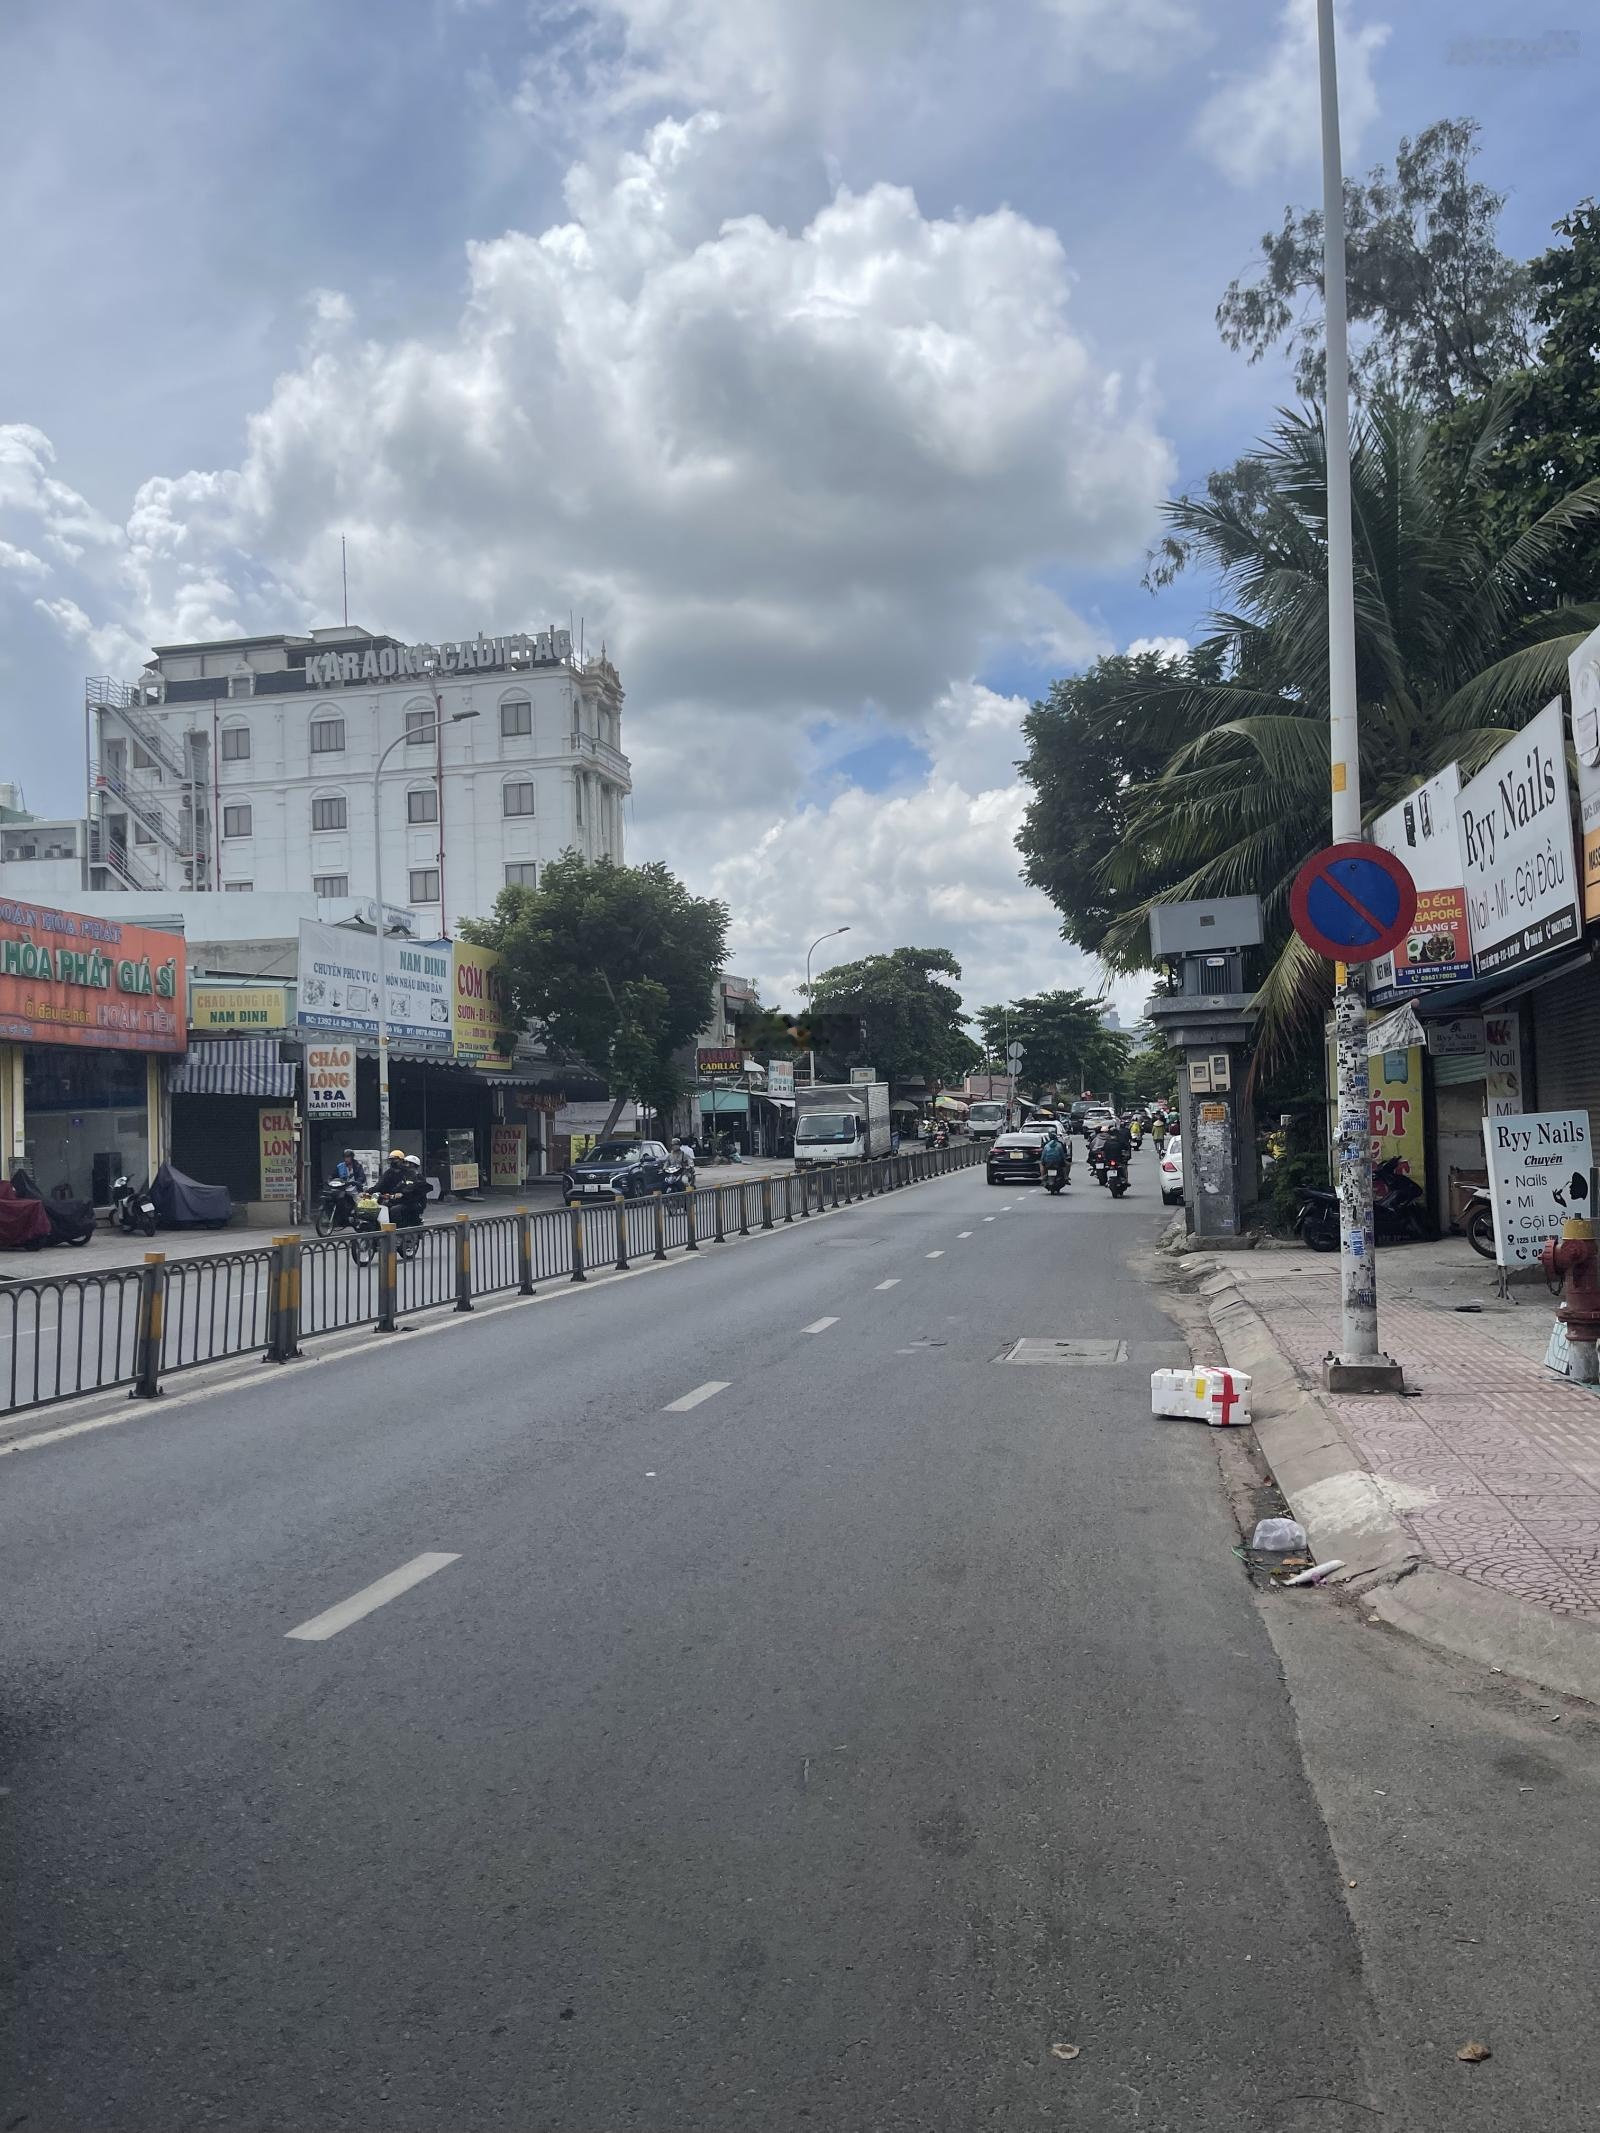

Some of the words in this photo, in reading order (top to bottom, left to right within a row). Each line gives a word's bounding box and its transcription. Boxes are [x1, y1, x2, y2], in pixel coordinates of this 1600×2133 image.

[306, 643, 434, 683] KARAOKE
[440, 629, 571, 671] CADILLAC
[1462, 809, 1496, 872] Ryy
[1498, 746, 1556, 840] Nails
[1471, 889, 1490, 934] Nail
[1495, 878, 1509, 921] Mi
[1515, 857, 1537, 911] Gội
[1537, 838, 1564, 896] Đầu
[0, 903, 38, 928] OÀN
[42, 910, 77, 936] HÒA
[80, 919, 122, 944] PHÁT
[1415, 907, 1463, 923] GAPORE
[1408, 923, 1450, 935] ALLANG
[1450, 921, 1459, 930] 2
[2, 932, 54, 980] HÒA
[56, 947, 114, 989] PHÁT
[117, 953, 154, 995] GIÁ
[313, 961, 343, 979] CHUYÊN
[343, 967, 361, 982] PHỤC
[361, 971, 372, 984] VỤ
[399, 950, 422, 974] NAM
[424, 956, 447, 980] ĐỊNH
[457, 961, 482, 999] CƠM
[97, 1001, 140, 1030] HOÀN
[144, 1001, 177, 1033] TIỀN
[210, 1010, 236, 1024] NAM
[308, 1047, 351, 1068] CHÁO
[700, 1062, 741, 1071] CADILLAC
[1489, 1048, 1516, 1067] Nail
[308, 1068, 350, 1089] LÒNG
[313, 1090, 346, 1101] 18A
[308, 1102, 329, 1110] NAM
[330, 1102, 351, 1111] ĐỊNH
[1369, 1089, 1410, 1137] ÉT
[1496, 1102, 1512, 1116] Mi
[262, 1111, 294, 1132] CHÁ
[263, 1135, 294, 1156] LÒN
[1497, 1126, 1532, 1152] Ryy
[1536, 1120, 1585, 1145] Nails
[1524, 1153, 1563, 1166] Chuyên
[1515, 1174, 1548, 1188] Nails
[1518, 1194, 1534, 1208] Mi
[1520, 1215, 1545, 1231] Gội
